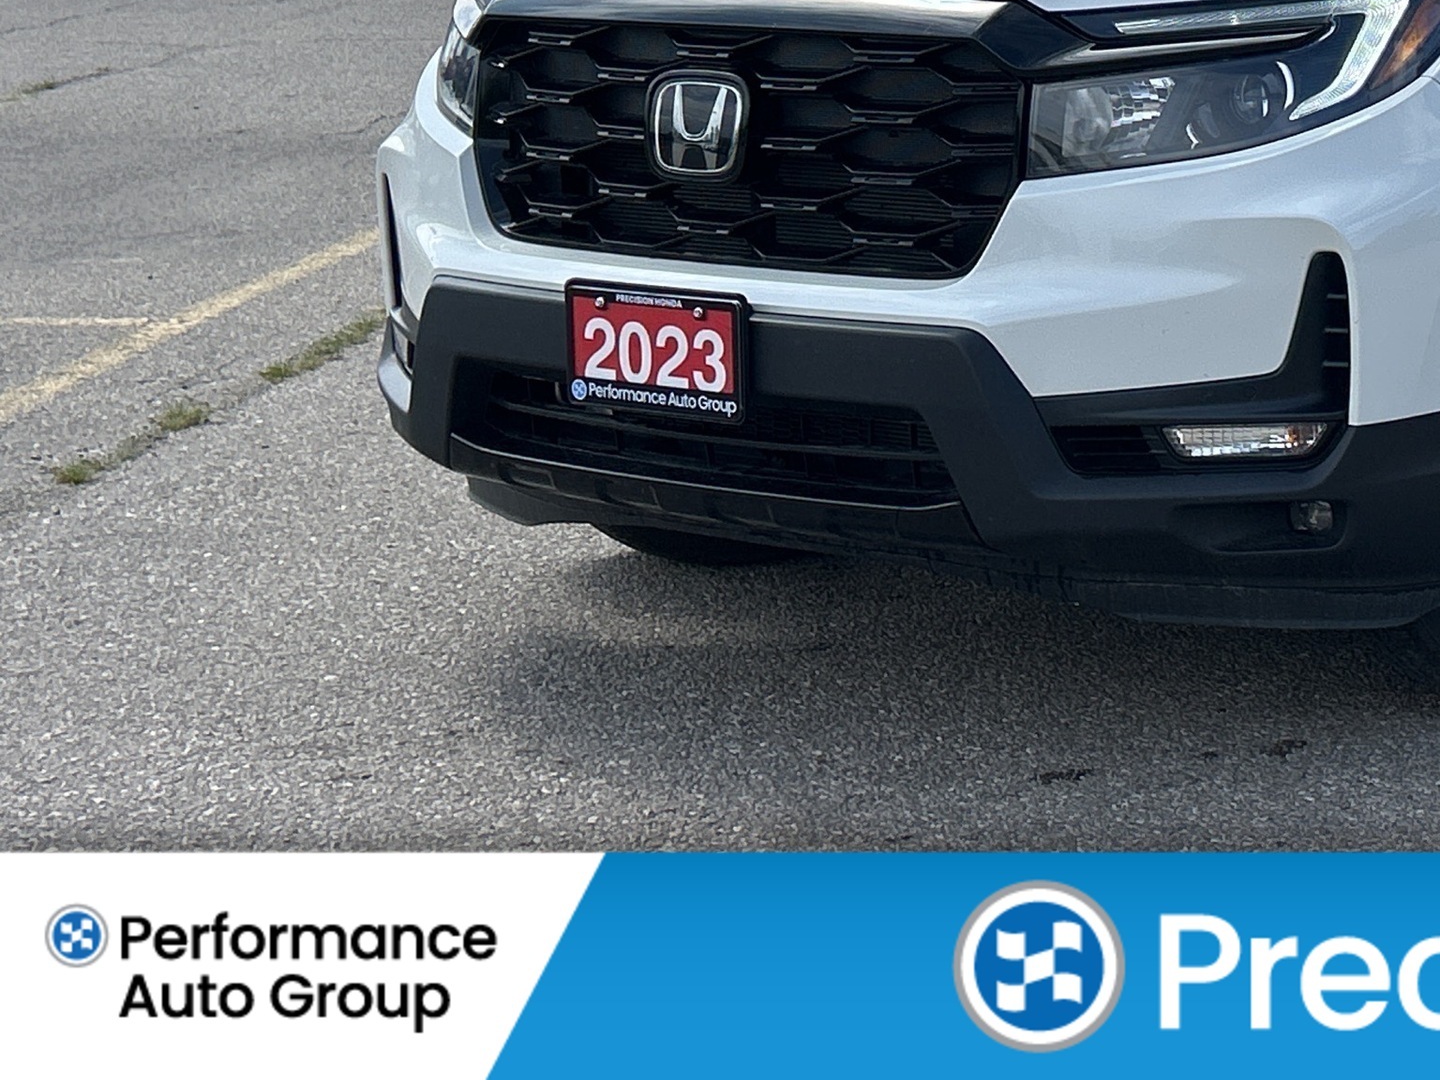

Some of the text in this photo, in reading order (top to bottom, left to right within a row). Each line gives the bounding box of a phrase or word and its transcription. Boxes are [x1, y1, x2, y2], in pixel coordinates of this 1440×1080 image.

[615, 293, 654, 306] PRECISION
[584, 316, 727, 394] 2023
[588, 382, 737, 418] Performance Auto Group
